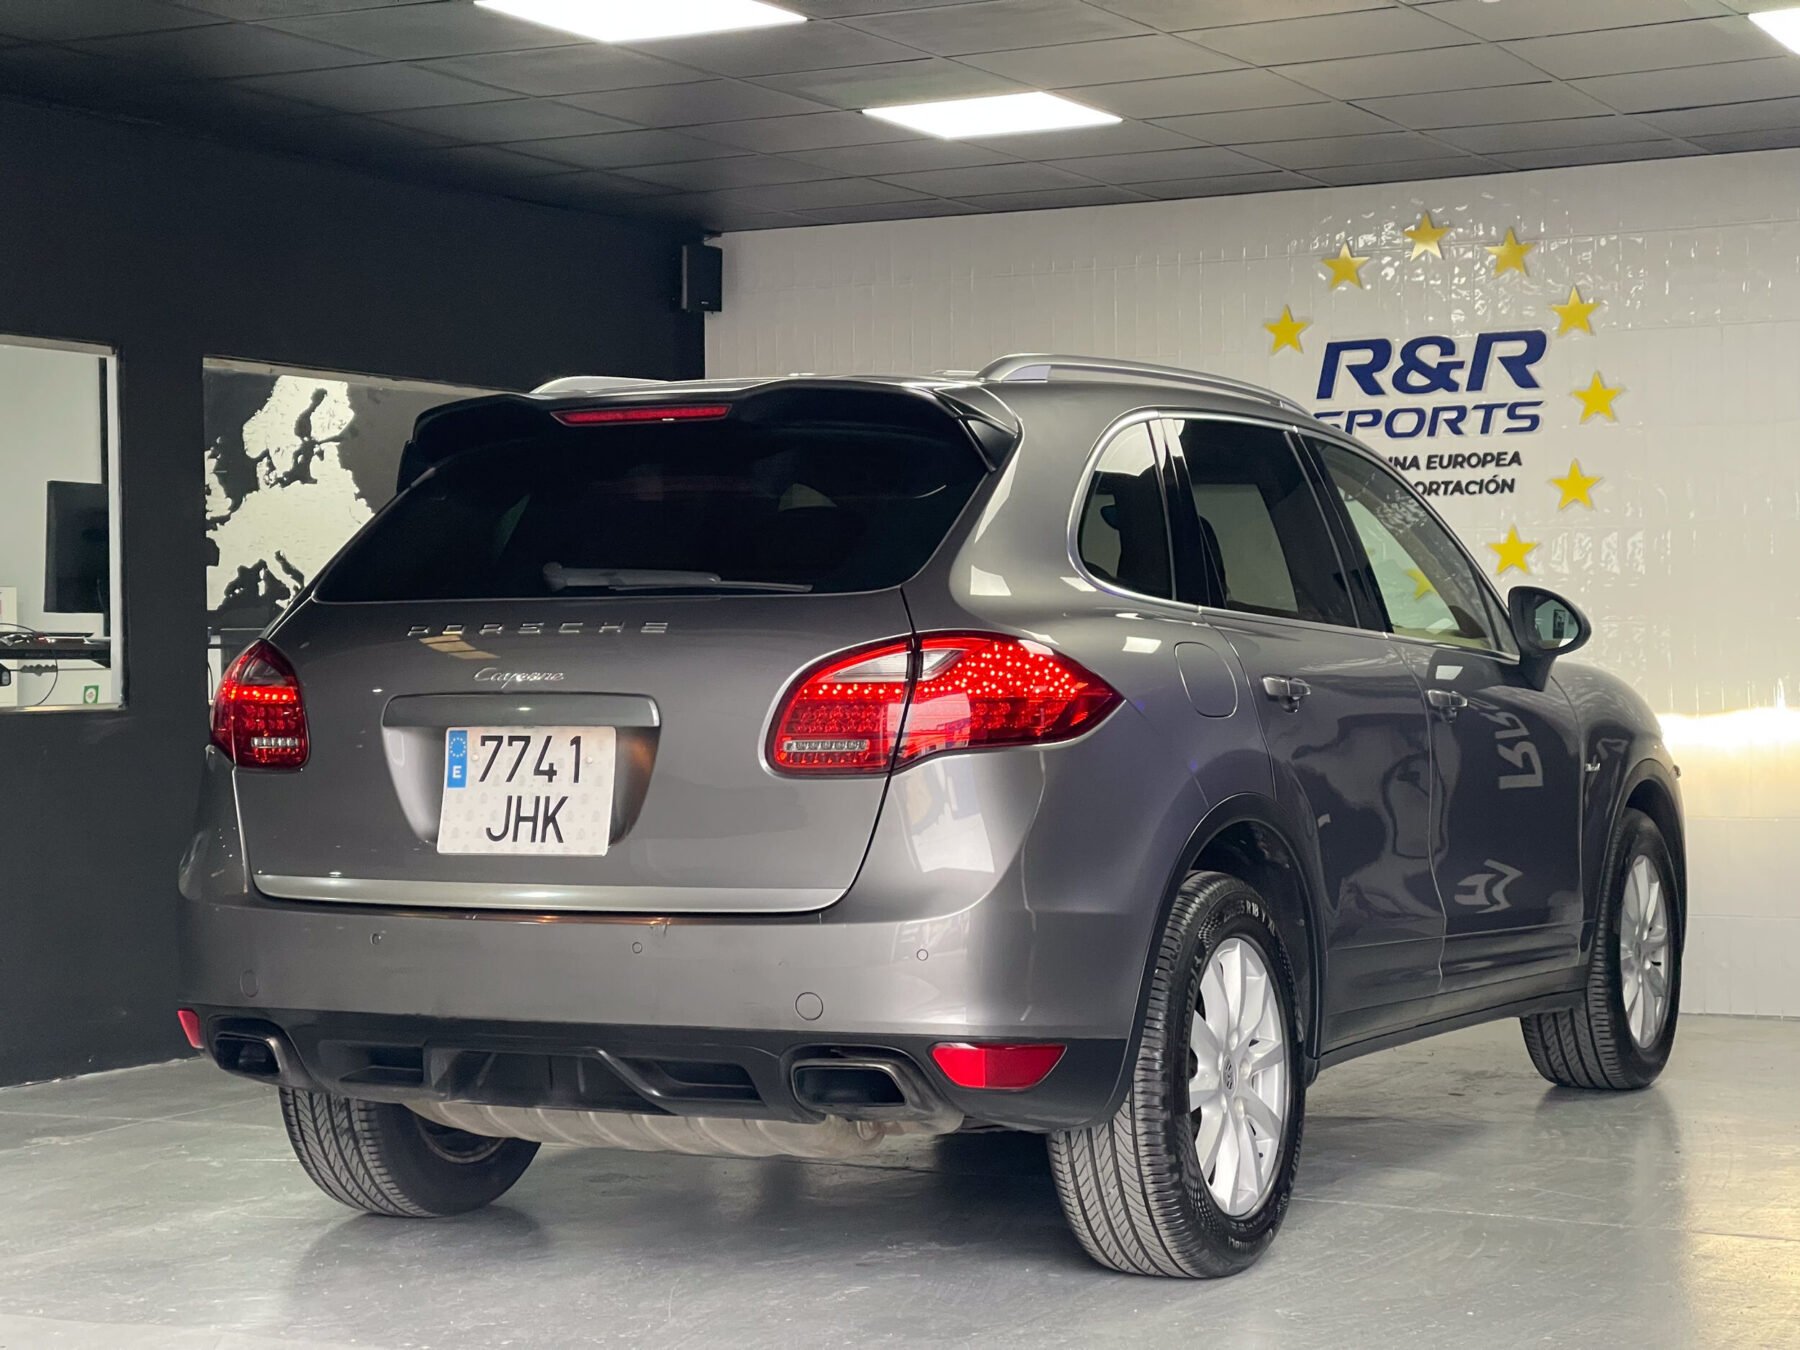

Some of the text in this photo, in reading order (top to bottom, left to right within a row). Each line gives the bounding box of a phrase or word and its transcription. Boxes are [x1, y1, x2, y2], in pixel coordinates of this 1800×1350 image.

[1316, 329, 1547, 400] R&R
[1426, 450, 1522, 470] EUROPEA
[1413, 473, 1515, 497] ORTACIÓN
[407, 622, 669, 637] PORSCHE
[479, 735, 582, 784] 7741
[452, 765, 462, 779] E
[485, 794, 569, 844] JHK
